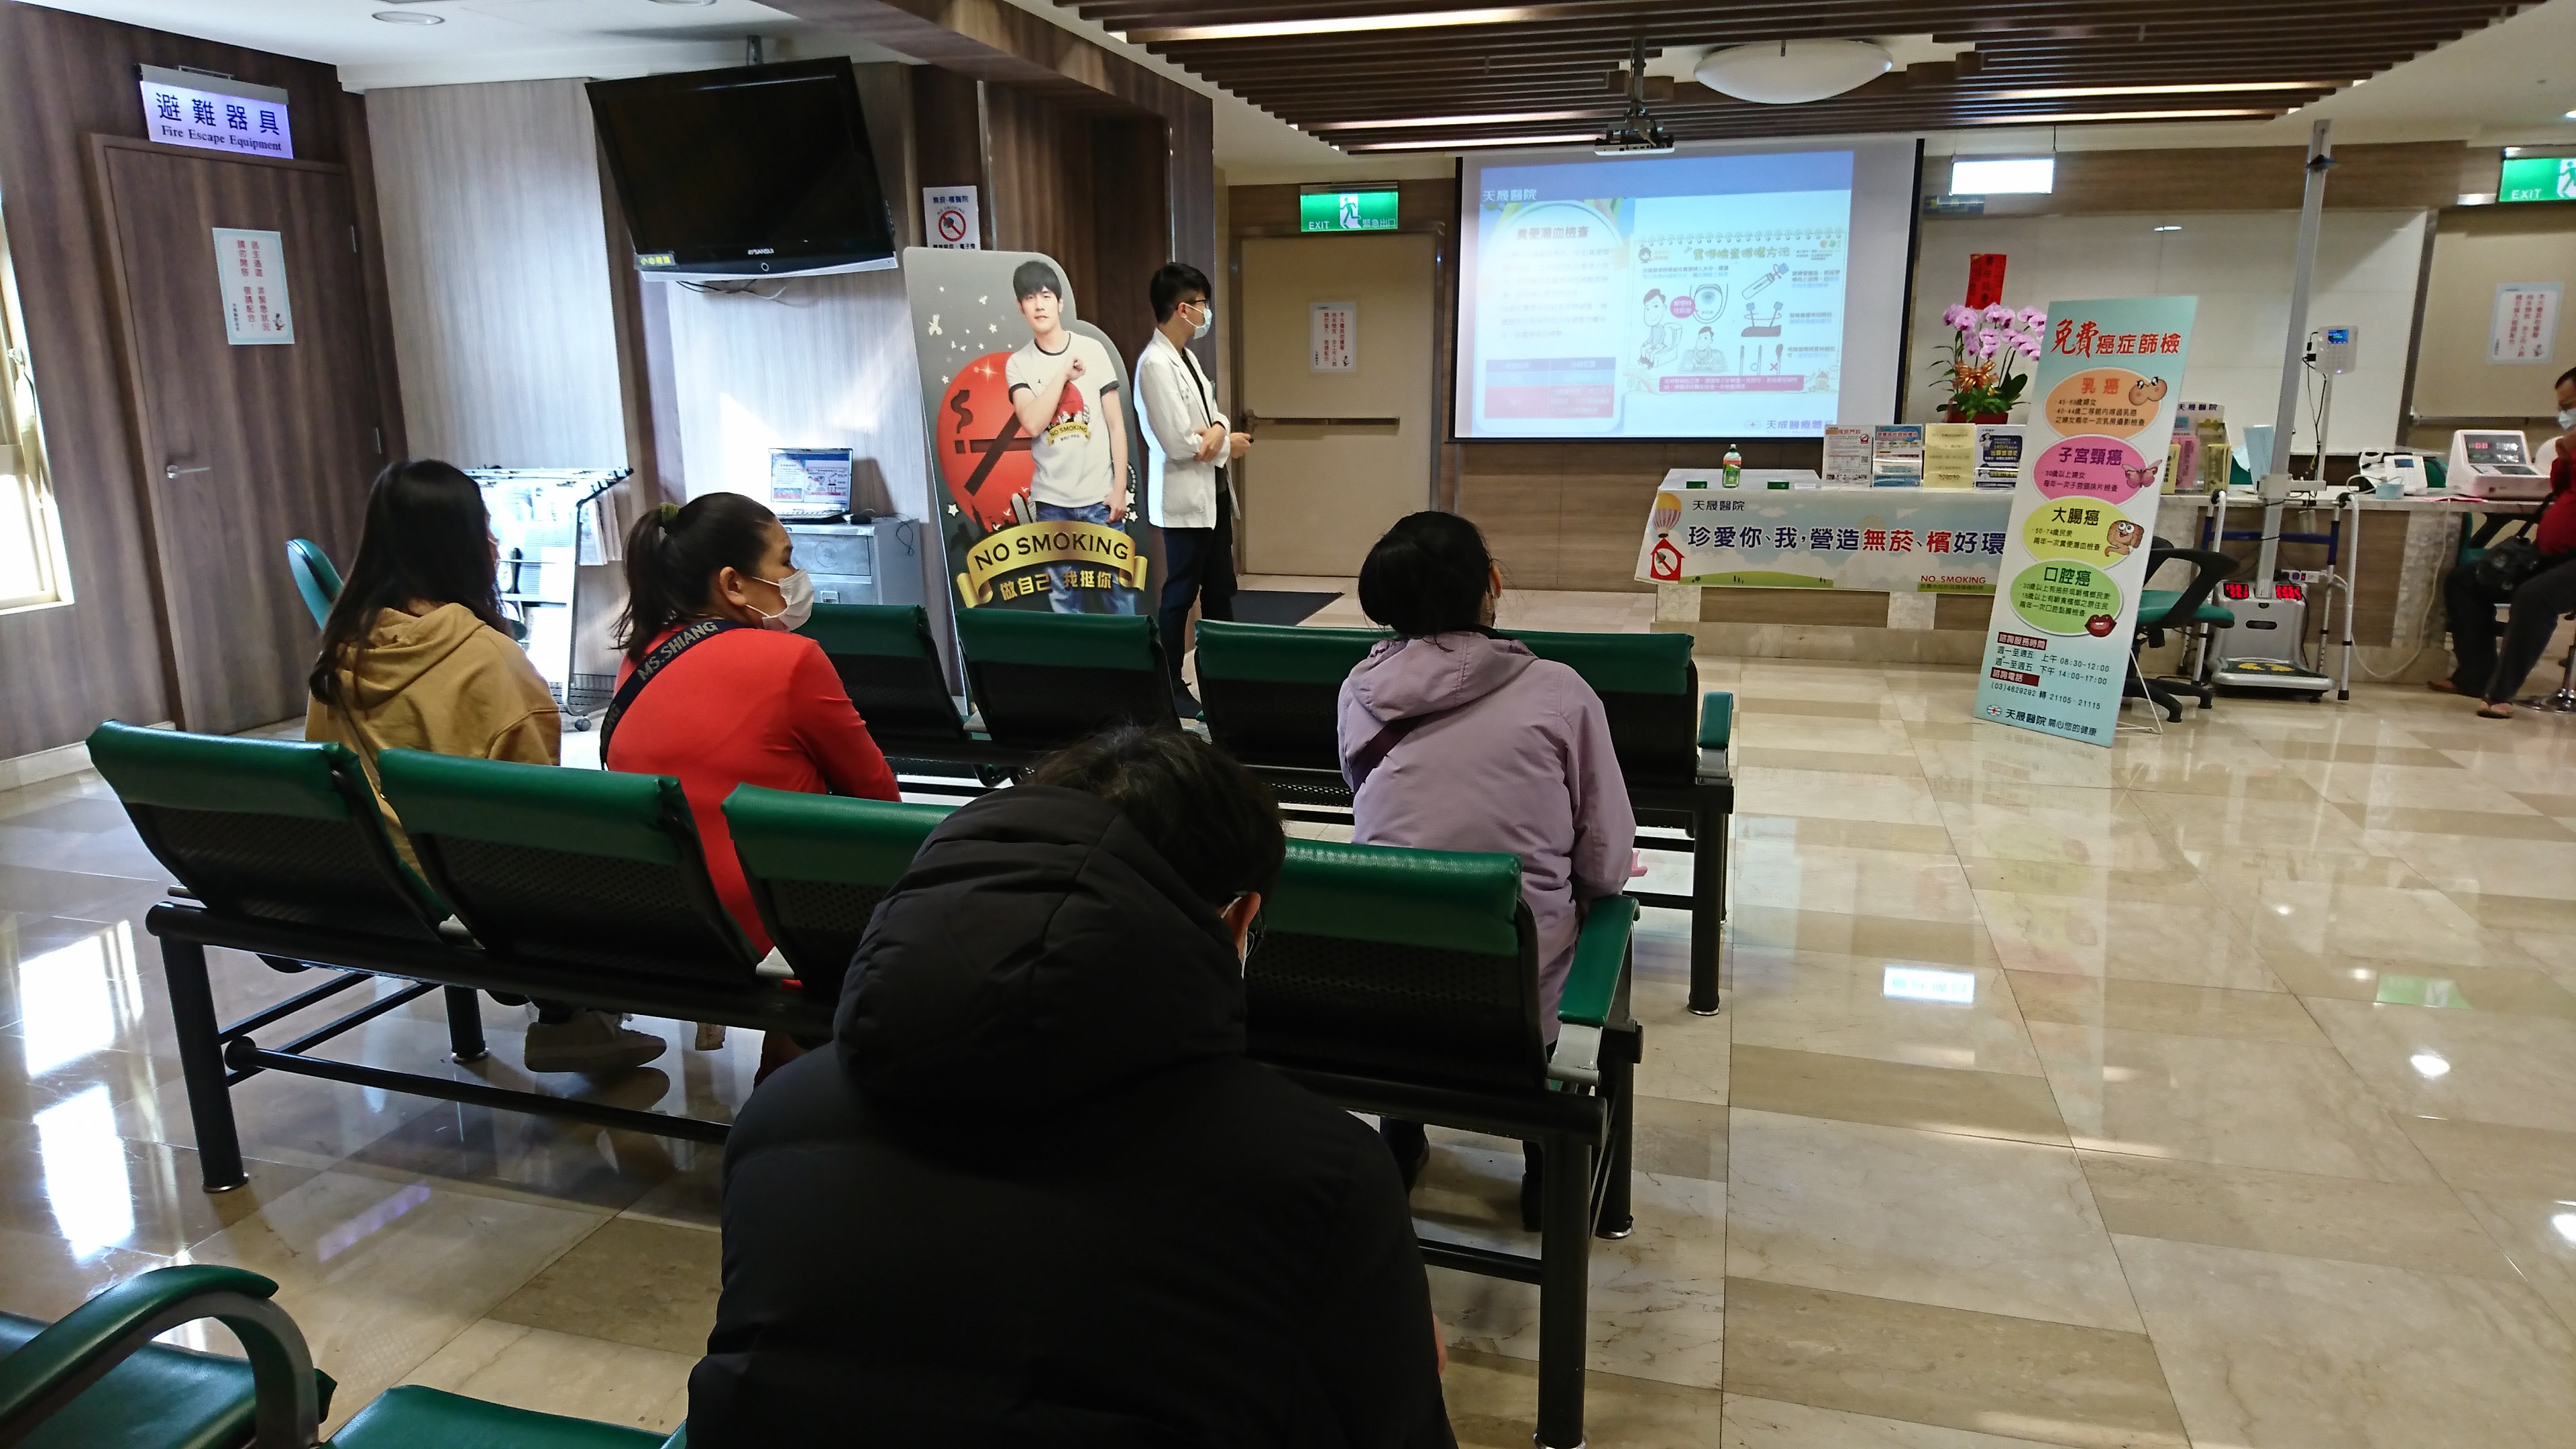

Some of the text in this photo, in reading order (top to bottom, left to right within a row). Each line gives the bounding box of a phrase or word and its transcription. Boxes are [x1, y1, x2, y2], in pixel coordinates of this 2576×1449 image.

[156, 93, 280, 135] 避難器具
[162, 125, 282, 151] Fire Escape Equipment
[2512, 189, 2541, 199] EXIT
[1309, 221, 1330, 229] EXIT
[1362, 219, 1396, 228] 緊急出口
[2050, 319, 2181, 358] 免費癌症篩檢
[2082, 378, 2120, 394] 乳癌
[1051, 425, 1087, 437] NO SMOKING
[2059, 447, 2123, 466] 子宮頸癌
[2043, 480, 2118, 492] 每年一次子宮頸抹片檢查
[1693, 500, 1745, 511] 天晟醫院
[2052, 506, 2100, 525] 大腸癌
[974, 533, 1128, 571] NO SMOKING
[2033, 537, 2100, 551] 兩年一次糞便潛血檢查
[1941, 576, 1986, 584] SMOKING
[2044, 567, 2091, 586] 口腔癌
[1000, 570, 1112, 601] 做自己 我挺你
[2020, 601, 2086, 616] 兩年一次口腔黏膜檢查
[1999, 633, 2045, 649] 諮詢服務時間
[1997, 646, 2109, 672] 週一至週五 上午 08:30-12:00
[1993, 669, 2023, 682] 諮詢電話
[1995, 657, 2107, 685] 週一至週五 下午 14:00-17:00
[2039, 691, 2047, 699] 轉
[2006, 709, 2097, 737] 天晟醫院 關心您的健康
